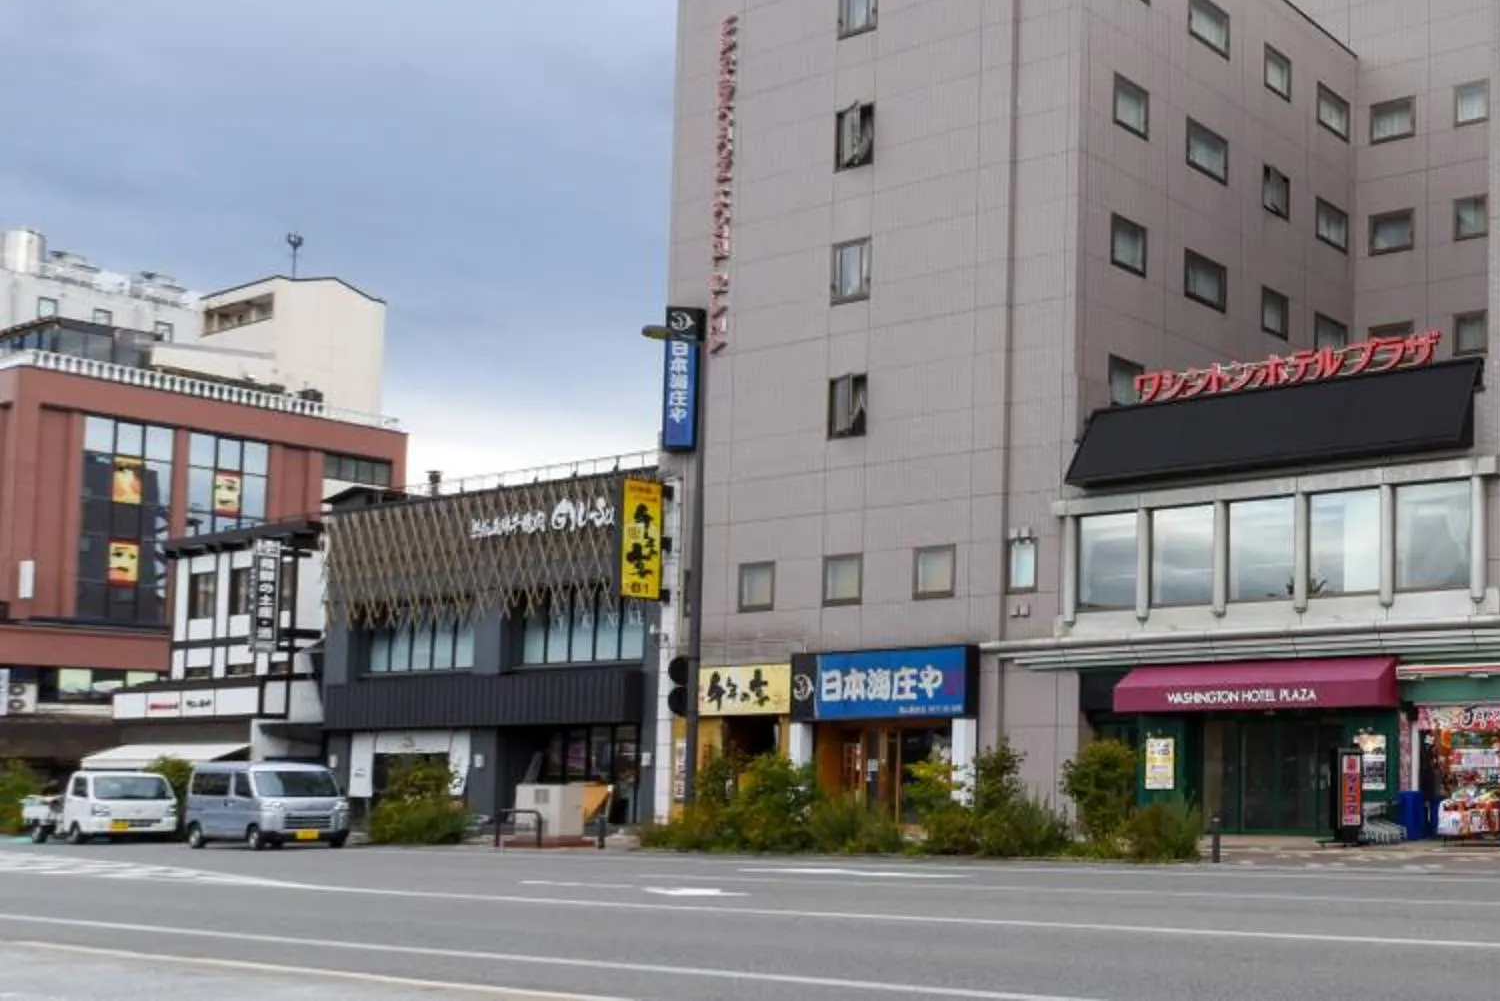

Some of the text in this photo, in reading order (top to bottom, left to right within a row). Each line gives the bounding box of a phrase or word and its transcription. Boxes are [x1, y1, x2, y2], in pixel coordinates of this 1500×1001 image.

[1134, 329, 1442, 404] ワシントンホテルプラザ
[1166, 688, 1317, 704] WASHINGTON HOTEL PLAZA
